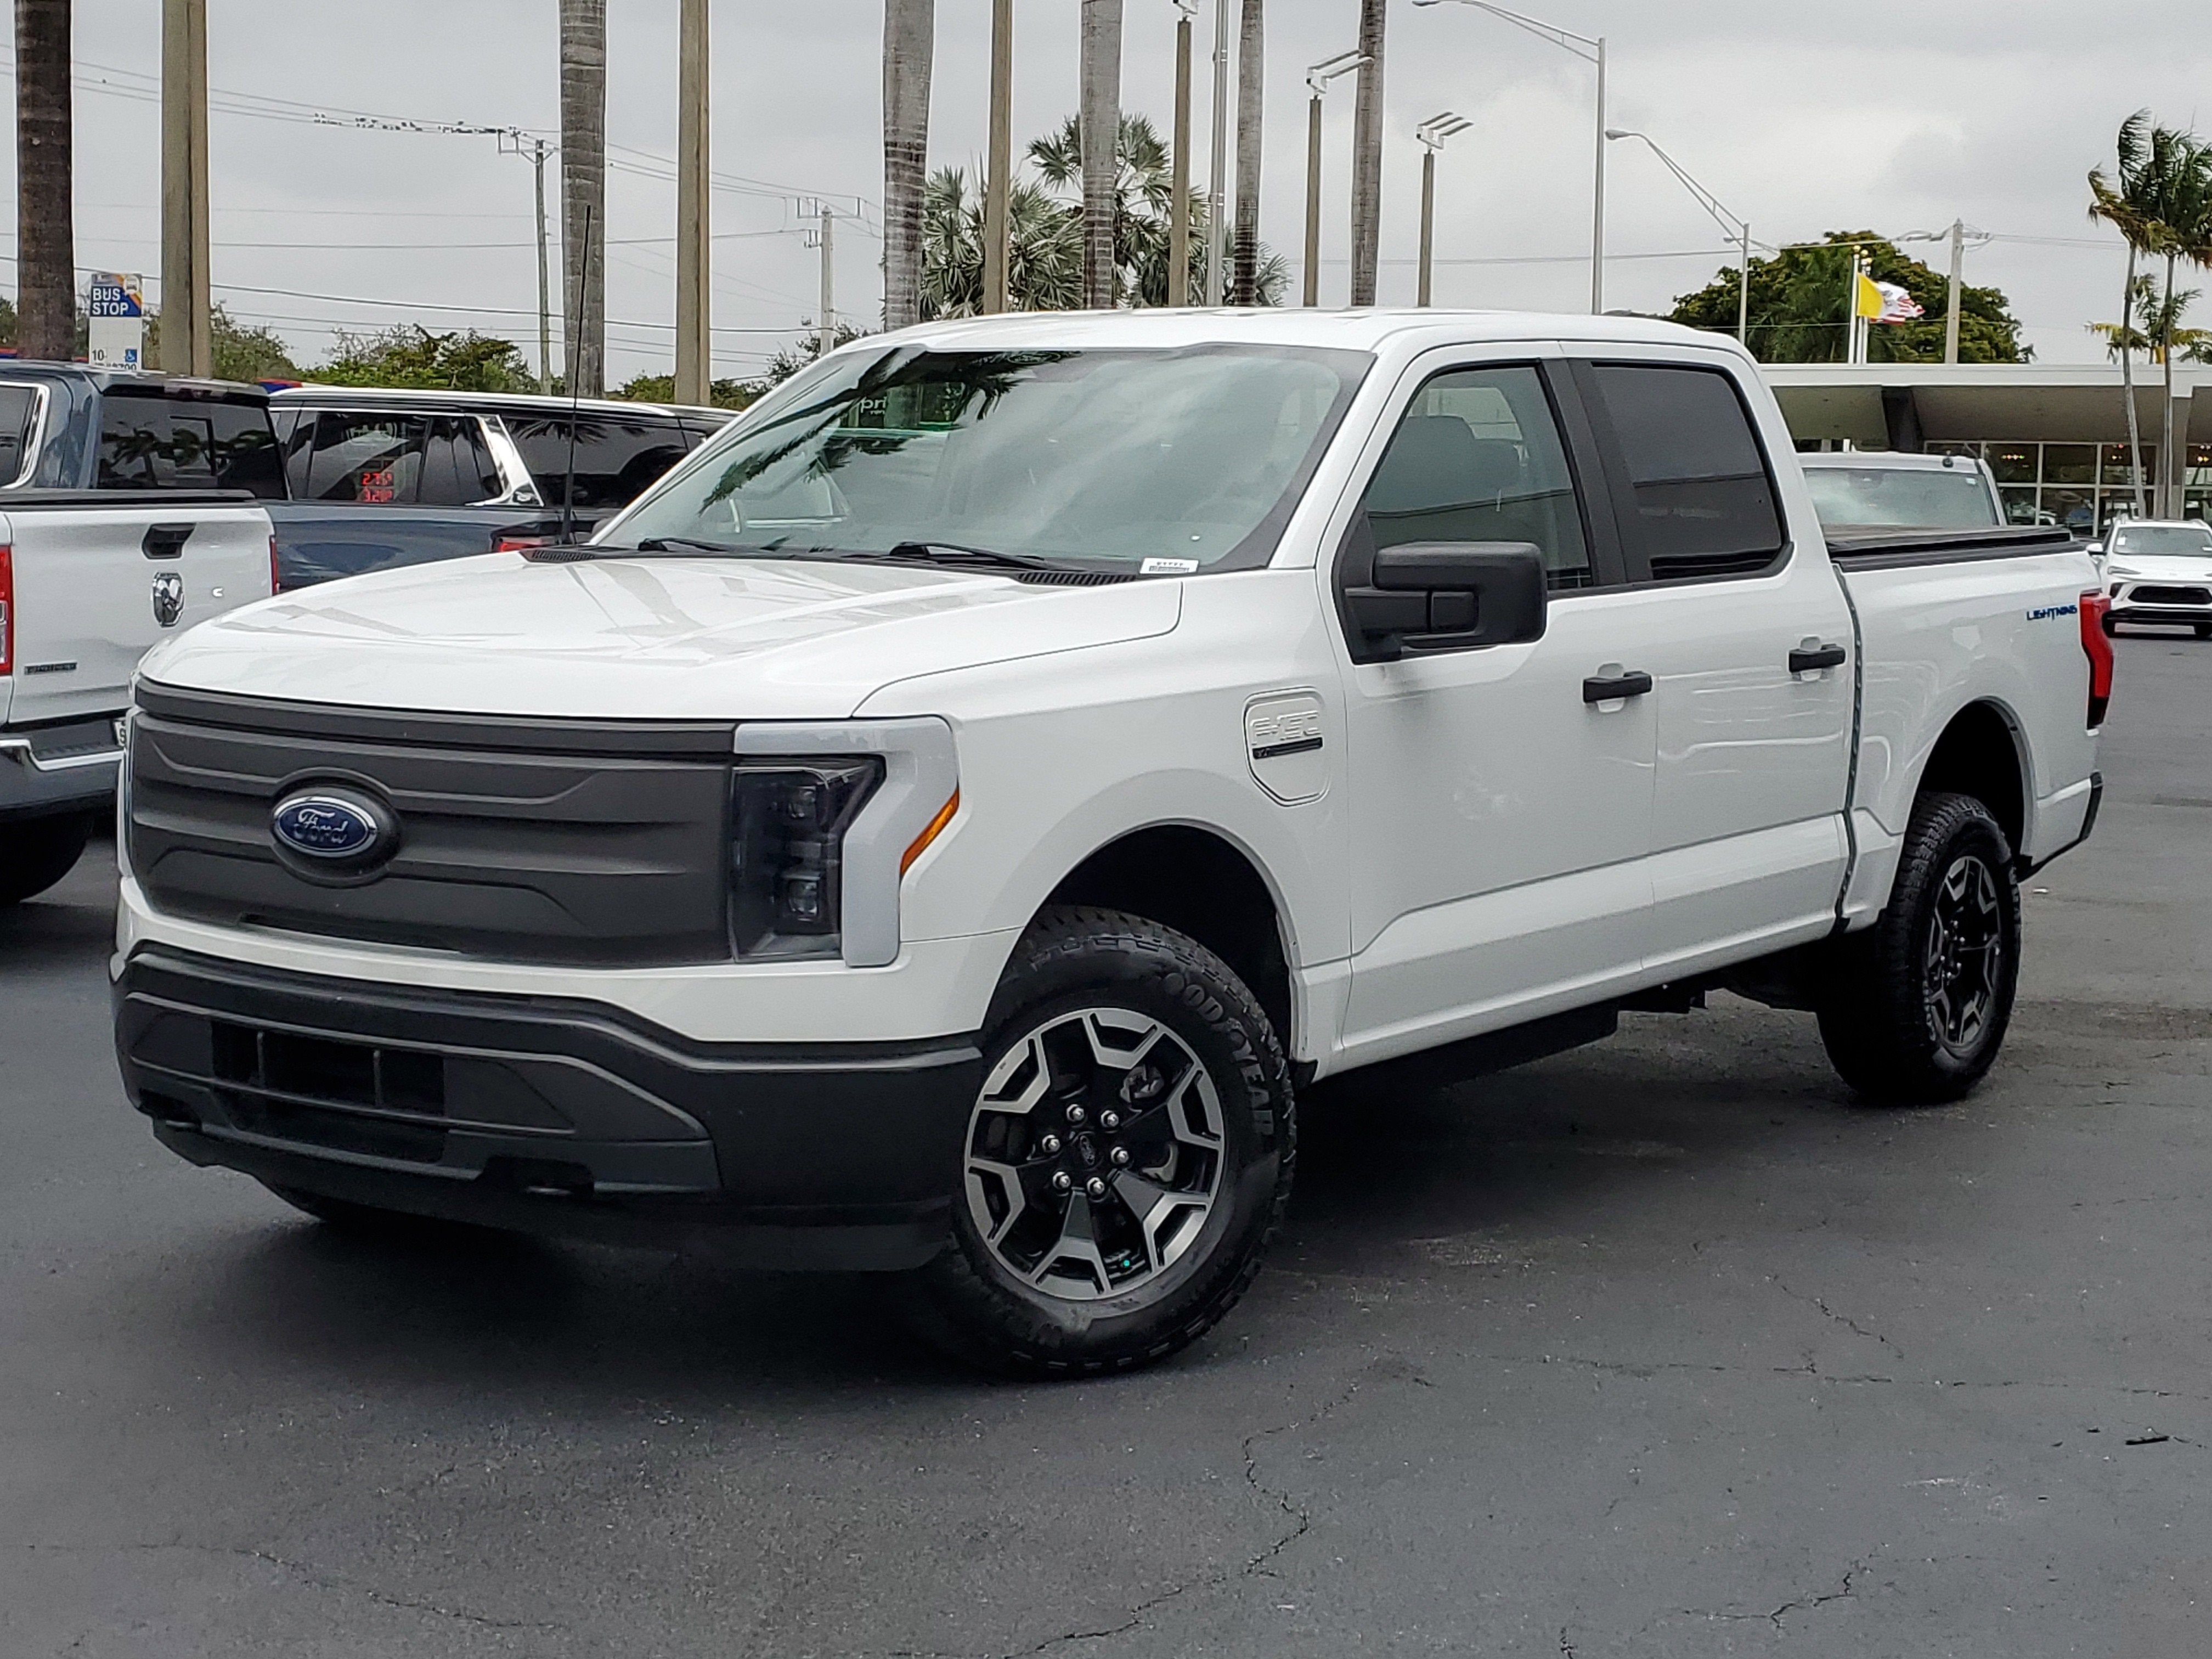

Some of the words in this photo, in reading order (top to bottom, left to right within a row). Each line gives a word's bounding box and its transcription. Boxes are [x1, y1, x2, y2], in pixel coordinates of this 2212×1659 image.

[93, 288, 120, 301] BUS
[92, 302, 128, 315] STOP
[294, 808, 348, 844] Ford
